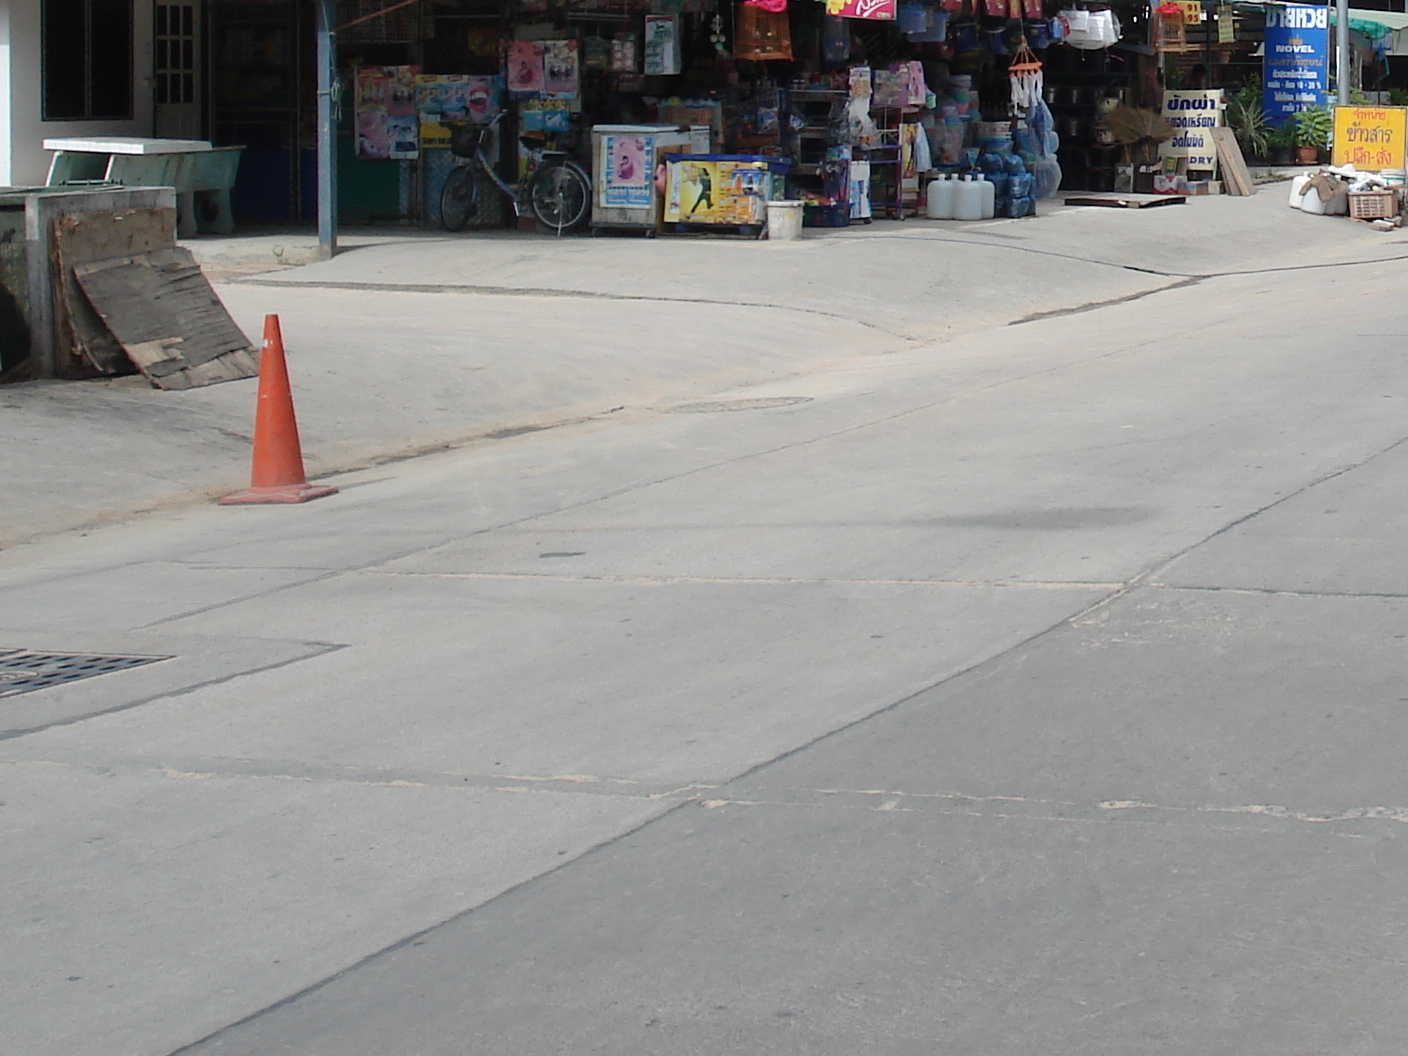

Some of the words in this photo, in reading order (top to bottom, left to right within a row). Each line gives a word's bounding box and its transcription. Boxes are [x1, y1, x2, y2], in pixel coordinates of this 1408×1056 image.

[1275, 44, 1316, 53] NOVEL
[1346, 121, 1393, 143] ข้าวสาร
